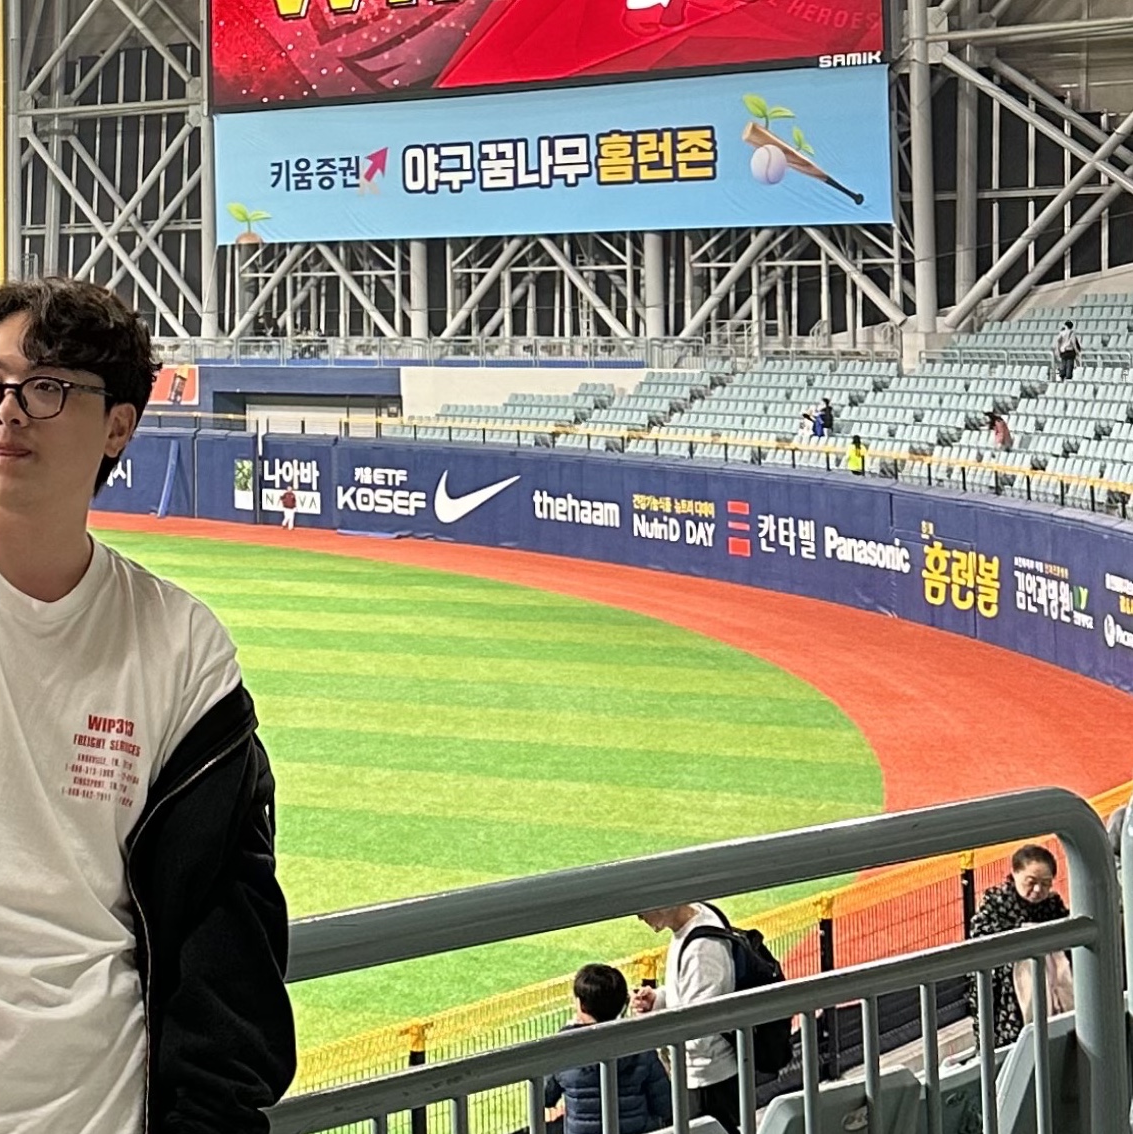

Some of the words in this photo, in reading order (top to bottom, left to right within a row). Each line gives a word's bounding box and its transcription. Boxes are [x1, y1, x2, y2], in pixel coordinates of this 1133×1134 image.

[818, 51, 882, 68] SAMIK
[270, 155, 361, 192] 키움증권
[402, 142, 475, 195] 야구
[476, 134, 592, 192] 꿈나무
[594, 125, 718, 184] 홈런존
[263, 458, 320, 491] 나아바
[337, 486, 427, 516] KOSEF
[533, 489, 620, 528] thehaam
[633, 513, 680, 542] NutriD
[685, 519, 715, 547] DAY
[758, 513, 816, 560] 칸타빌
[824, 526, 911, 574] Panasonic
[921, 541, 1001, 619] 홈런볼
[1013, 570, 1073, 624] 김안과병원
[88, 714, 134, 737] WIP313
[74, 733, 105, 749] FREIGHT
[109, 740, 141, 757] SERVICES
